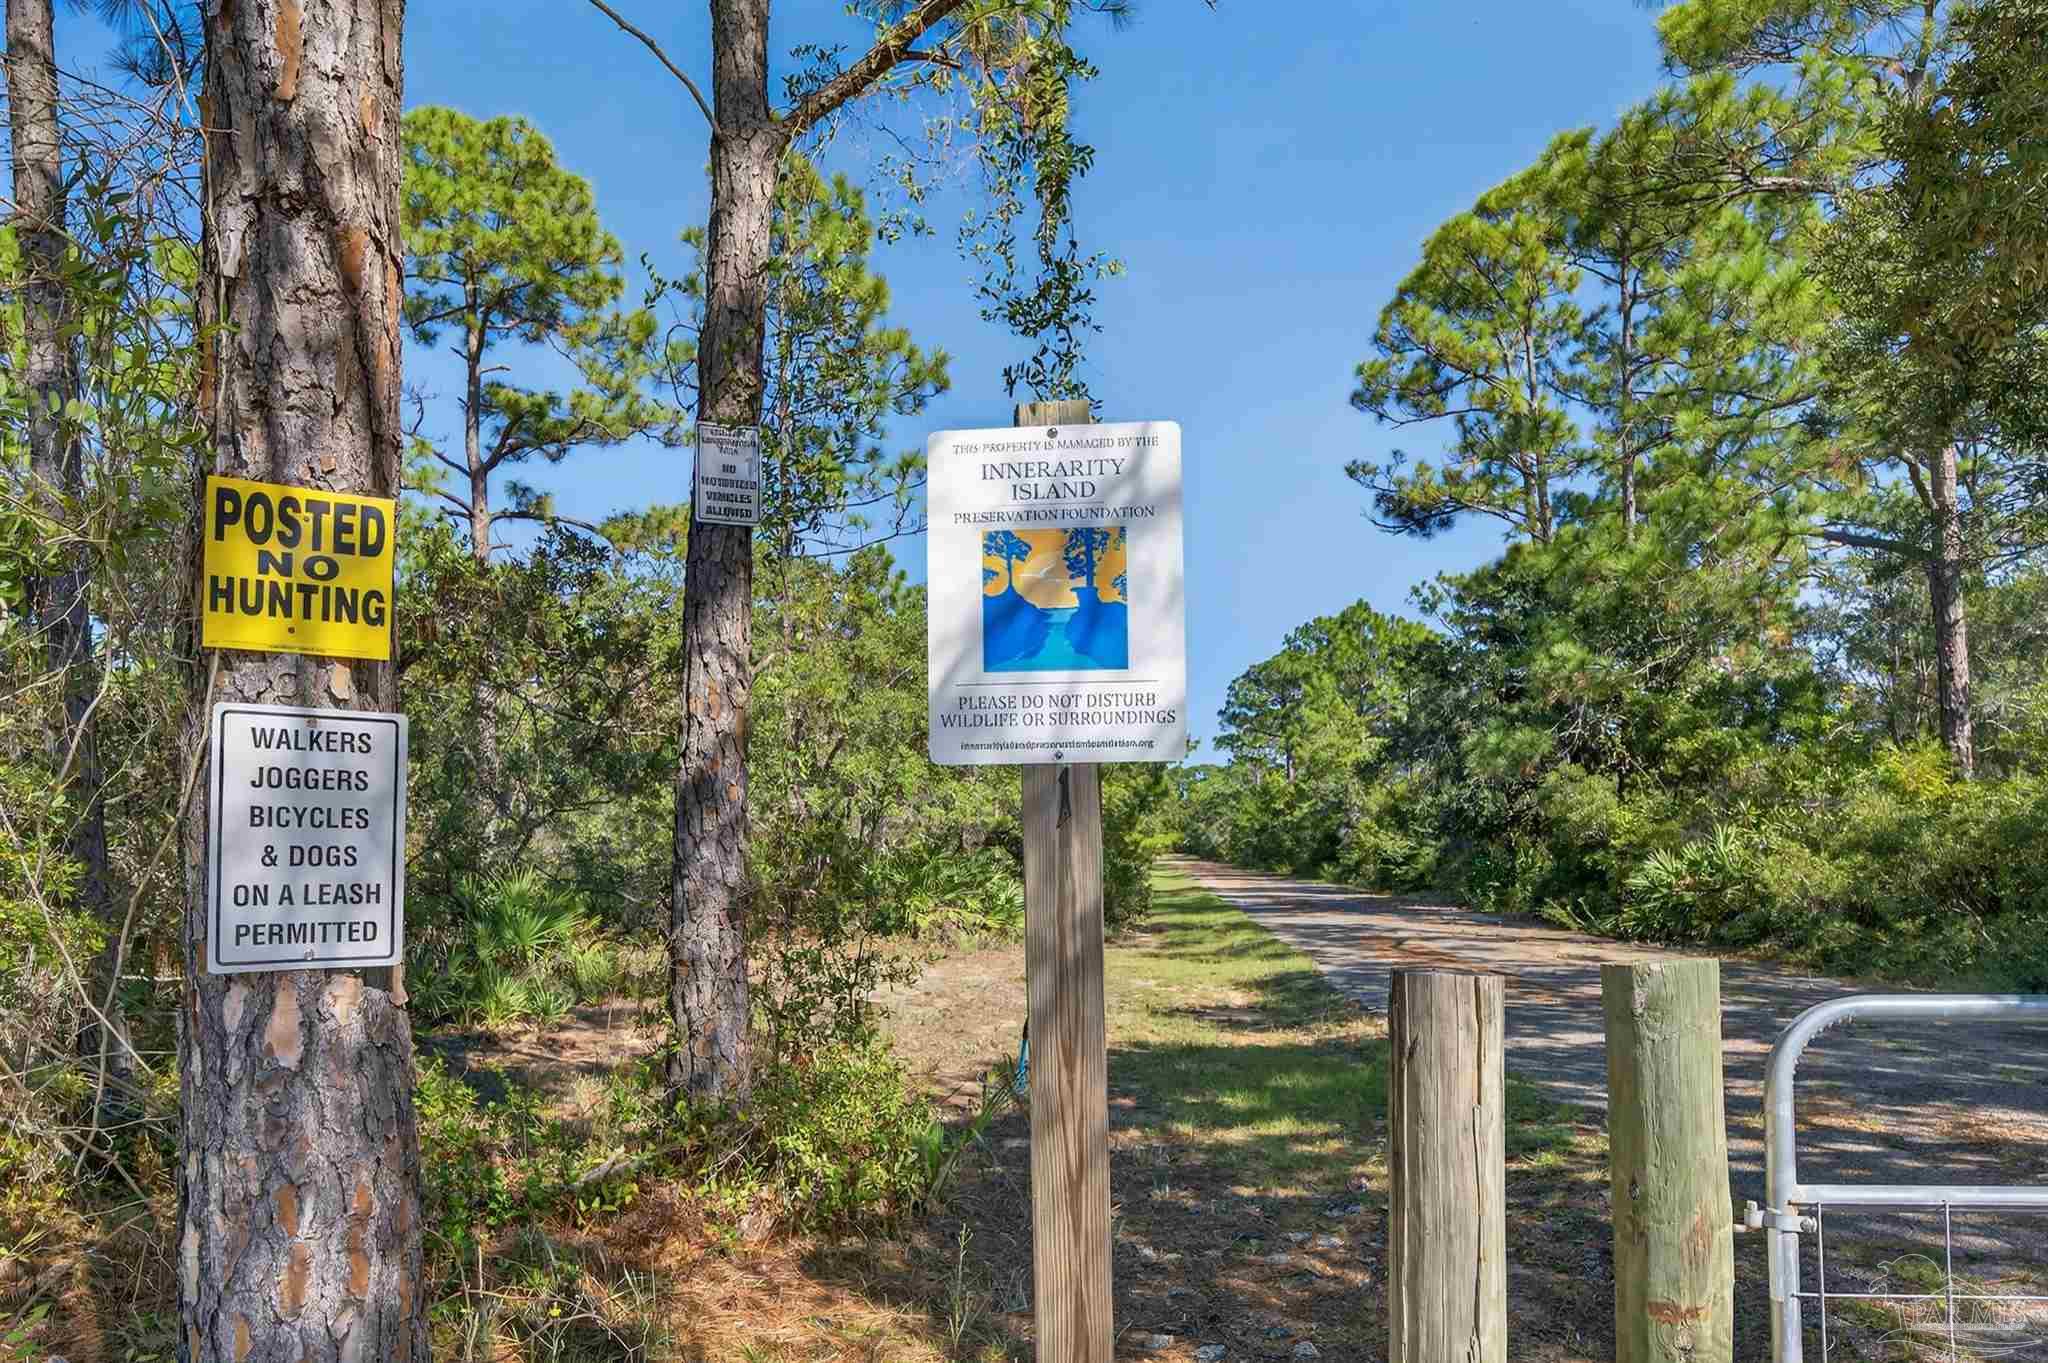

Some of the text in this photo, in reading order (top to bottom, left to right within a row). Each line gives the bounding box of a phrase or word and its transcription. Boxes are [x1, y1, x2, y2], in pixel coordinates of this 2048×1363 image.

[952, 436, 1159, 456] THIS PROPERTY IS MANAGED BY THE
[981, 458, 1126, 481] INNERARITY
[705, 491, 752, 503] VEHICLES
[1012, 481, 1096, 501] ISLAND
[215, 487, 386, 558] POSTED
[705, 505, 752, 518] ALLOWED
[953, 505, 1155, 524] PRESERVATION FOUNDATION
[257, 549, 340, 581] NO
[209, 575, 386, 627] HUNTING
[958, 692, 1157, 711] PLEASE DO NOT DISTURB
[940, 709, 1177, 728] WILDLIFE OR SURROUNDINGS
[251, 727, 372, 754] WALKERS
[250, 766, 369, 791] JOGGERS
[249, 805, 369, 829] BICYCLES
[261, 845, 358, 867] & DOGS
[233, 883, 381, 907] ON A LEASH
[235, 921, 378, 946] PERMITTED
